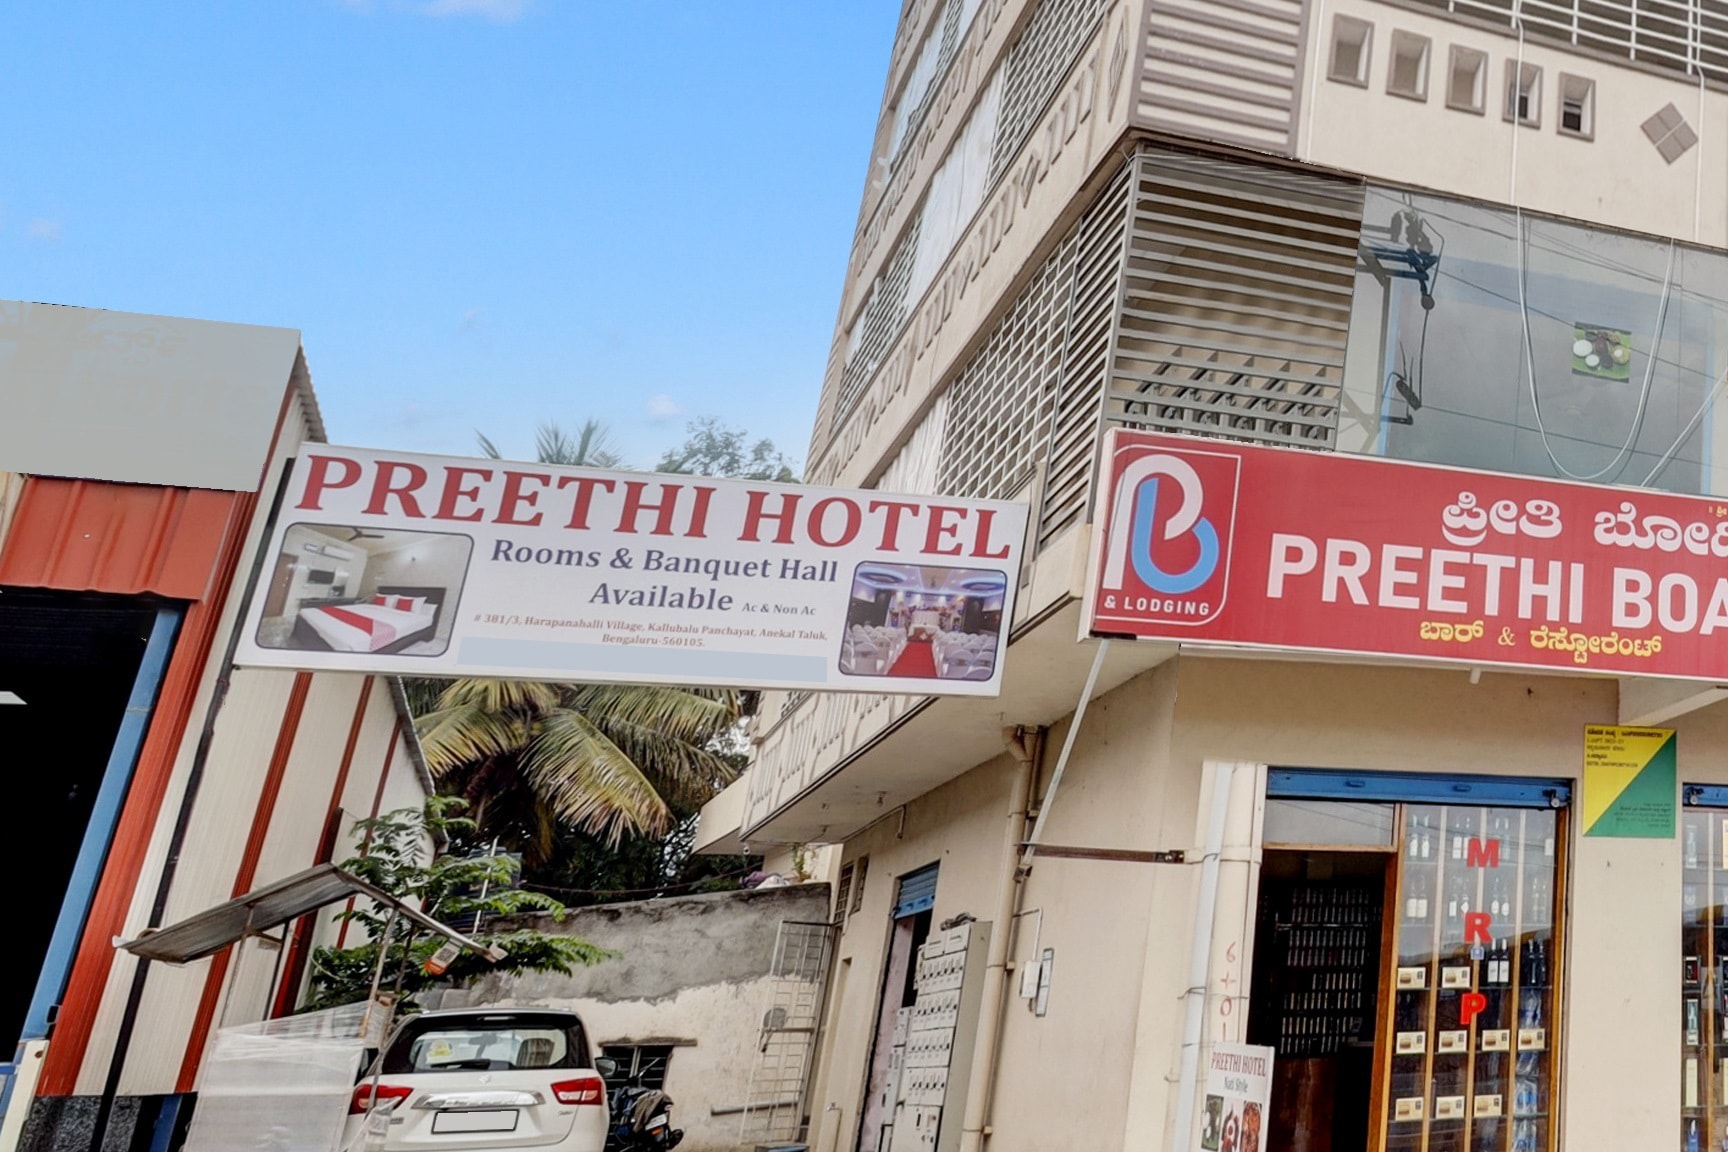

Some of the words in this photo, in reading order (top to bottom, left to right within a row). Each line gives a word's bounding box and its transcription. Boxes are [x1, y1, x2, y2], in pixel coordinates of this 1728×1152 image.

[295, 454, 716, 538] PREETHI
[736, 490, 1011, 560] HOTEL
[1442, 491, 1562, 547] ಪ್ರೀತಿ
[491, 539, 600, 568] Rooms
[609, 547, 633, 570] &
[643, 549, 771, 582] Banquet
[779, 558, 839, 583] Hall
[1266, 533, 1584, 624] PREETHI
[588, 583, 733, 611] Available
[742, 602, 758, 614] Ac
[760, 603, 770, 614] &
[773, 604, 799, 616] Non
[801, 605, 817, 616] Ac
[1104, 595, 1117, 611] &
[1123, 596, 1211, 616] LODGING
[524, 616, 604, 631] Harapanahalli
[606, 620, 645, 633] Village,
[760, 629, 795, 640] Anekal
[1498, 628, 1516, 646] &
[1211, 1052, 1241, 1072] PREETHI
[1242, 1054, 1267, 1077] HOTEL
